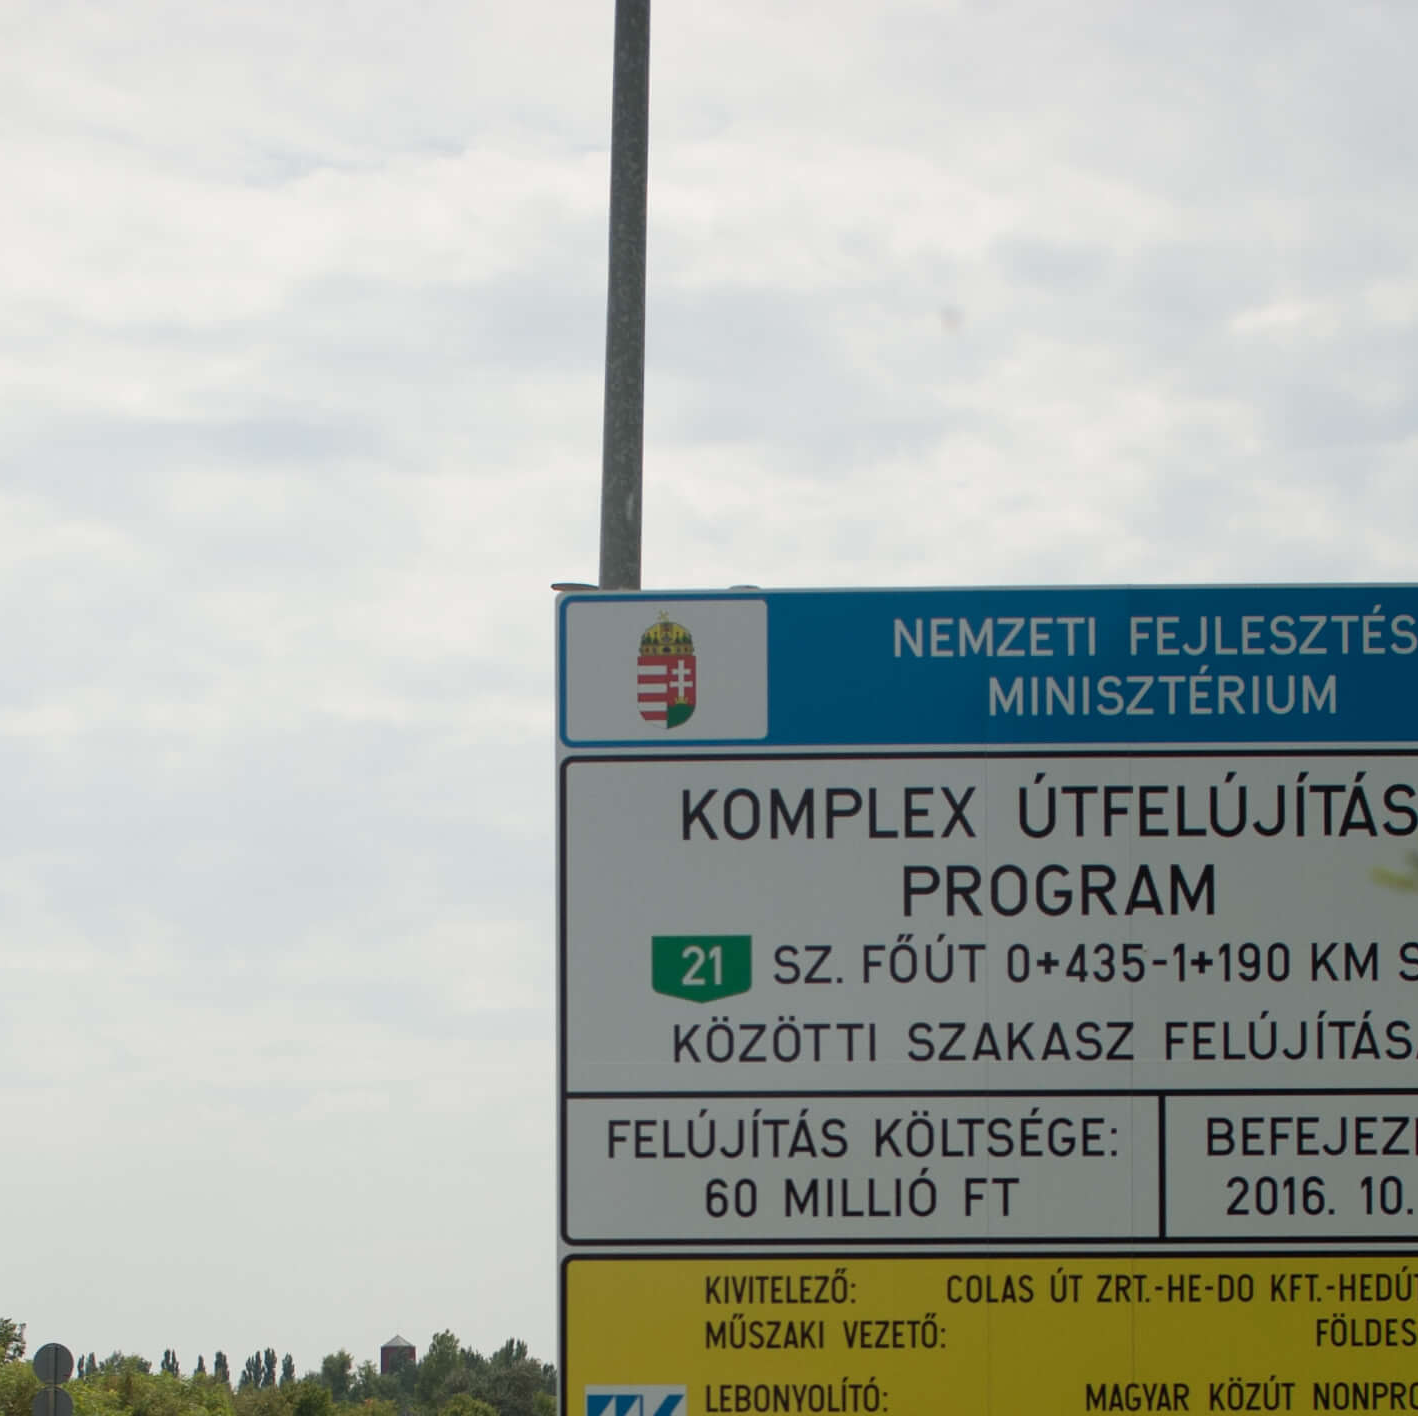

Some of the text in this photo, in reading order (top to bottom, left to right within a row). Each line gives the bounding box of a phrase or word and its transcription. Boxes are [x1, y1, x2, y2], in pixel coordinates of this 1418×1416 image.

[894, 617, 1095, 657] NEMZETI
[989, 667, 1336, 715] MINISZTÉRIUM
[683, 787, 975, 840] KOMPLEX
[904, 864, 1216, 916] PROGRAM
[682, 945, 723, 985] 21
[774, 946, 843, 984] SZ.
[864, 934, 986, 983] FŐÚT
[1008, 943, 1290, 982] 0+435-1+190
[1312, 943, 1378, 981] KM
[674, 1016, 876, 1062] KÖZÖTTI
[909, 1022, 1134, 1061] SZAKASZ
[609, 1107, 1119, 1158] FELÚJÍTÁS KÖLTSÉGE:
[705, 1168, 1020, 1218] 60 MILLIÓ FT
[1227, 1176, 1336, 1216] 2016.
[1361, 1176, 1415, 1215] 10.
[705, 1268, 857, 1304] KIVITELEZŐ:
[947, 1275, 1034, 1303] COLAS
[1051, 1267, 1082, 1303] ÚT
[705, 1313, 947, 1349] MŰSZAKI VEZETŐ:
[705, 1376, 889, 1412] LEBONYOLÍTÓ:
[1086, 1383, 1189, 1411] MAGYAR
[1210, 1376, 1295, 1411] KÖZÚT
